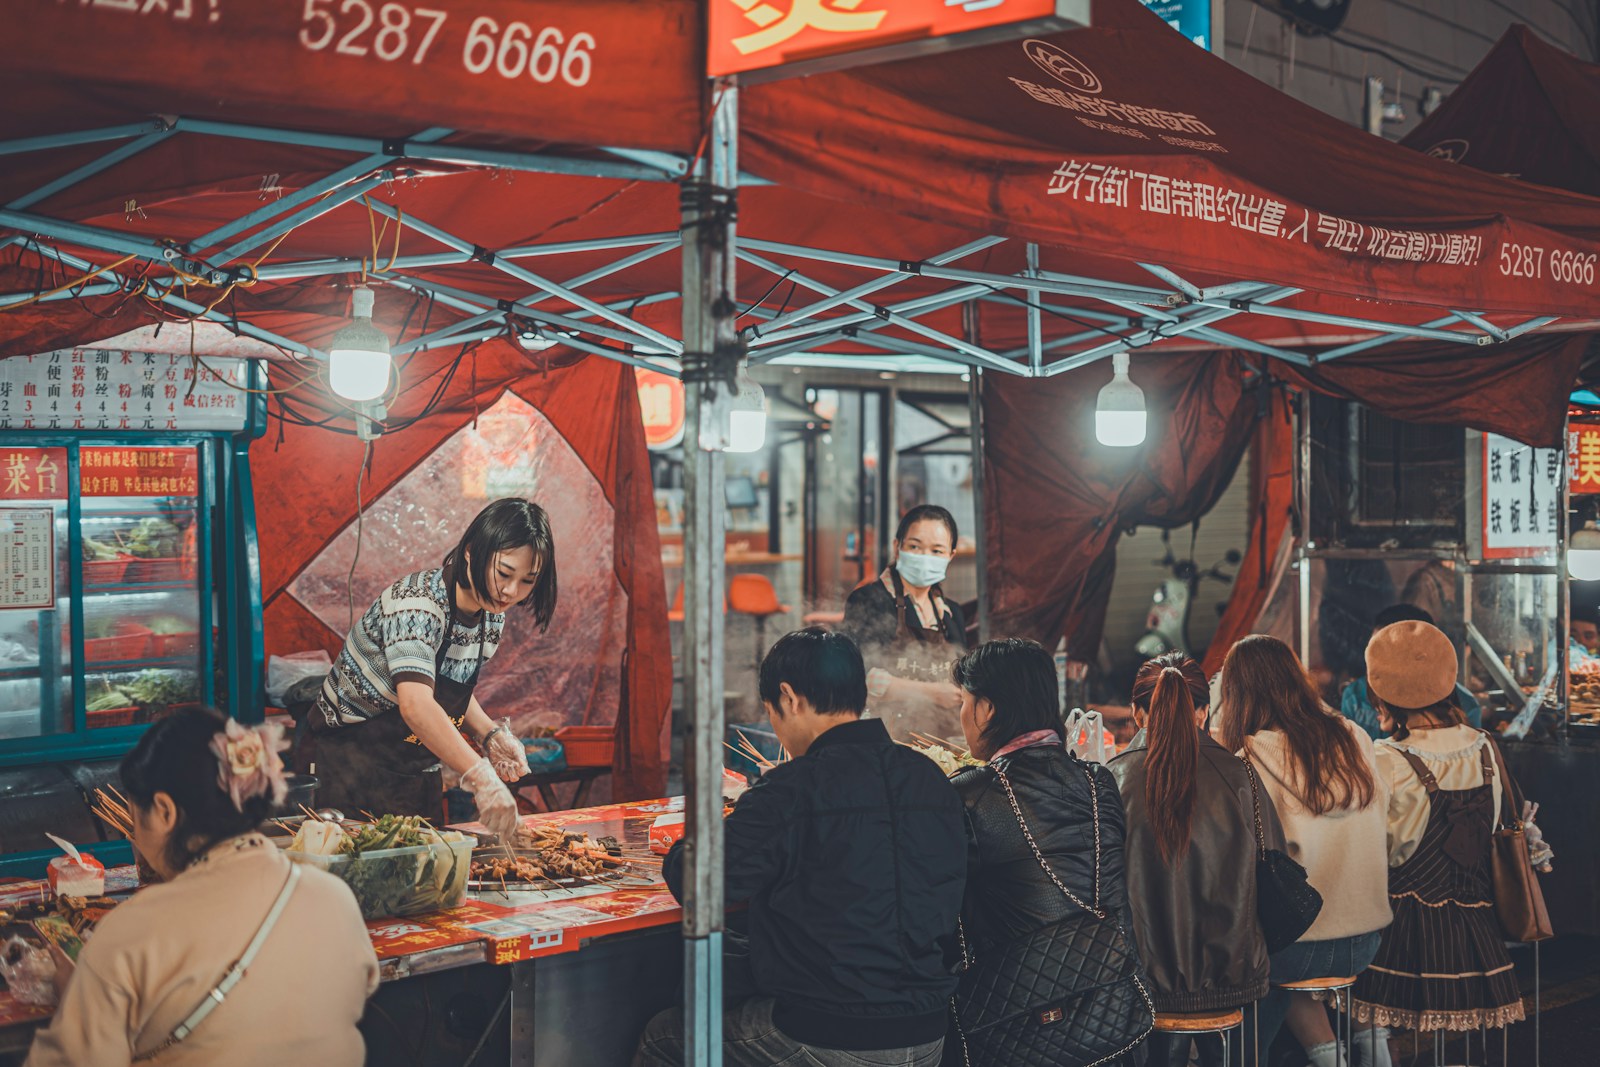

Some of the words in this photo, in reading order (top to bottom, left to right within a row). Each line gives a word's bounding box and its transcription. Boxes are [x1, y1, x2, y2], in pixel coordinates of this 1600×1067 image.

[300, 0, 447, 65] 5287
[463, 16, 596, 87] 6666
[1500, 243, 1544, 279] 5287
[1550, 249, 1597, 285] 6666
[3, 453, 59, 495] 菜台
